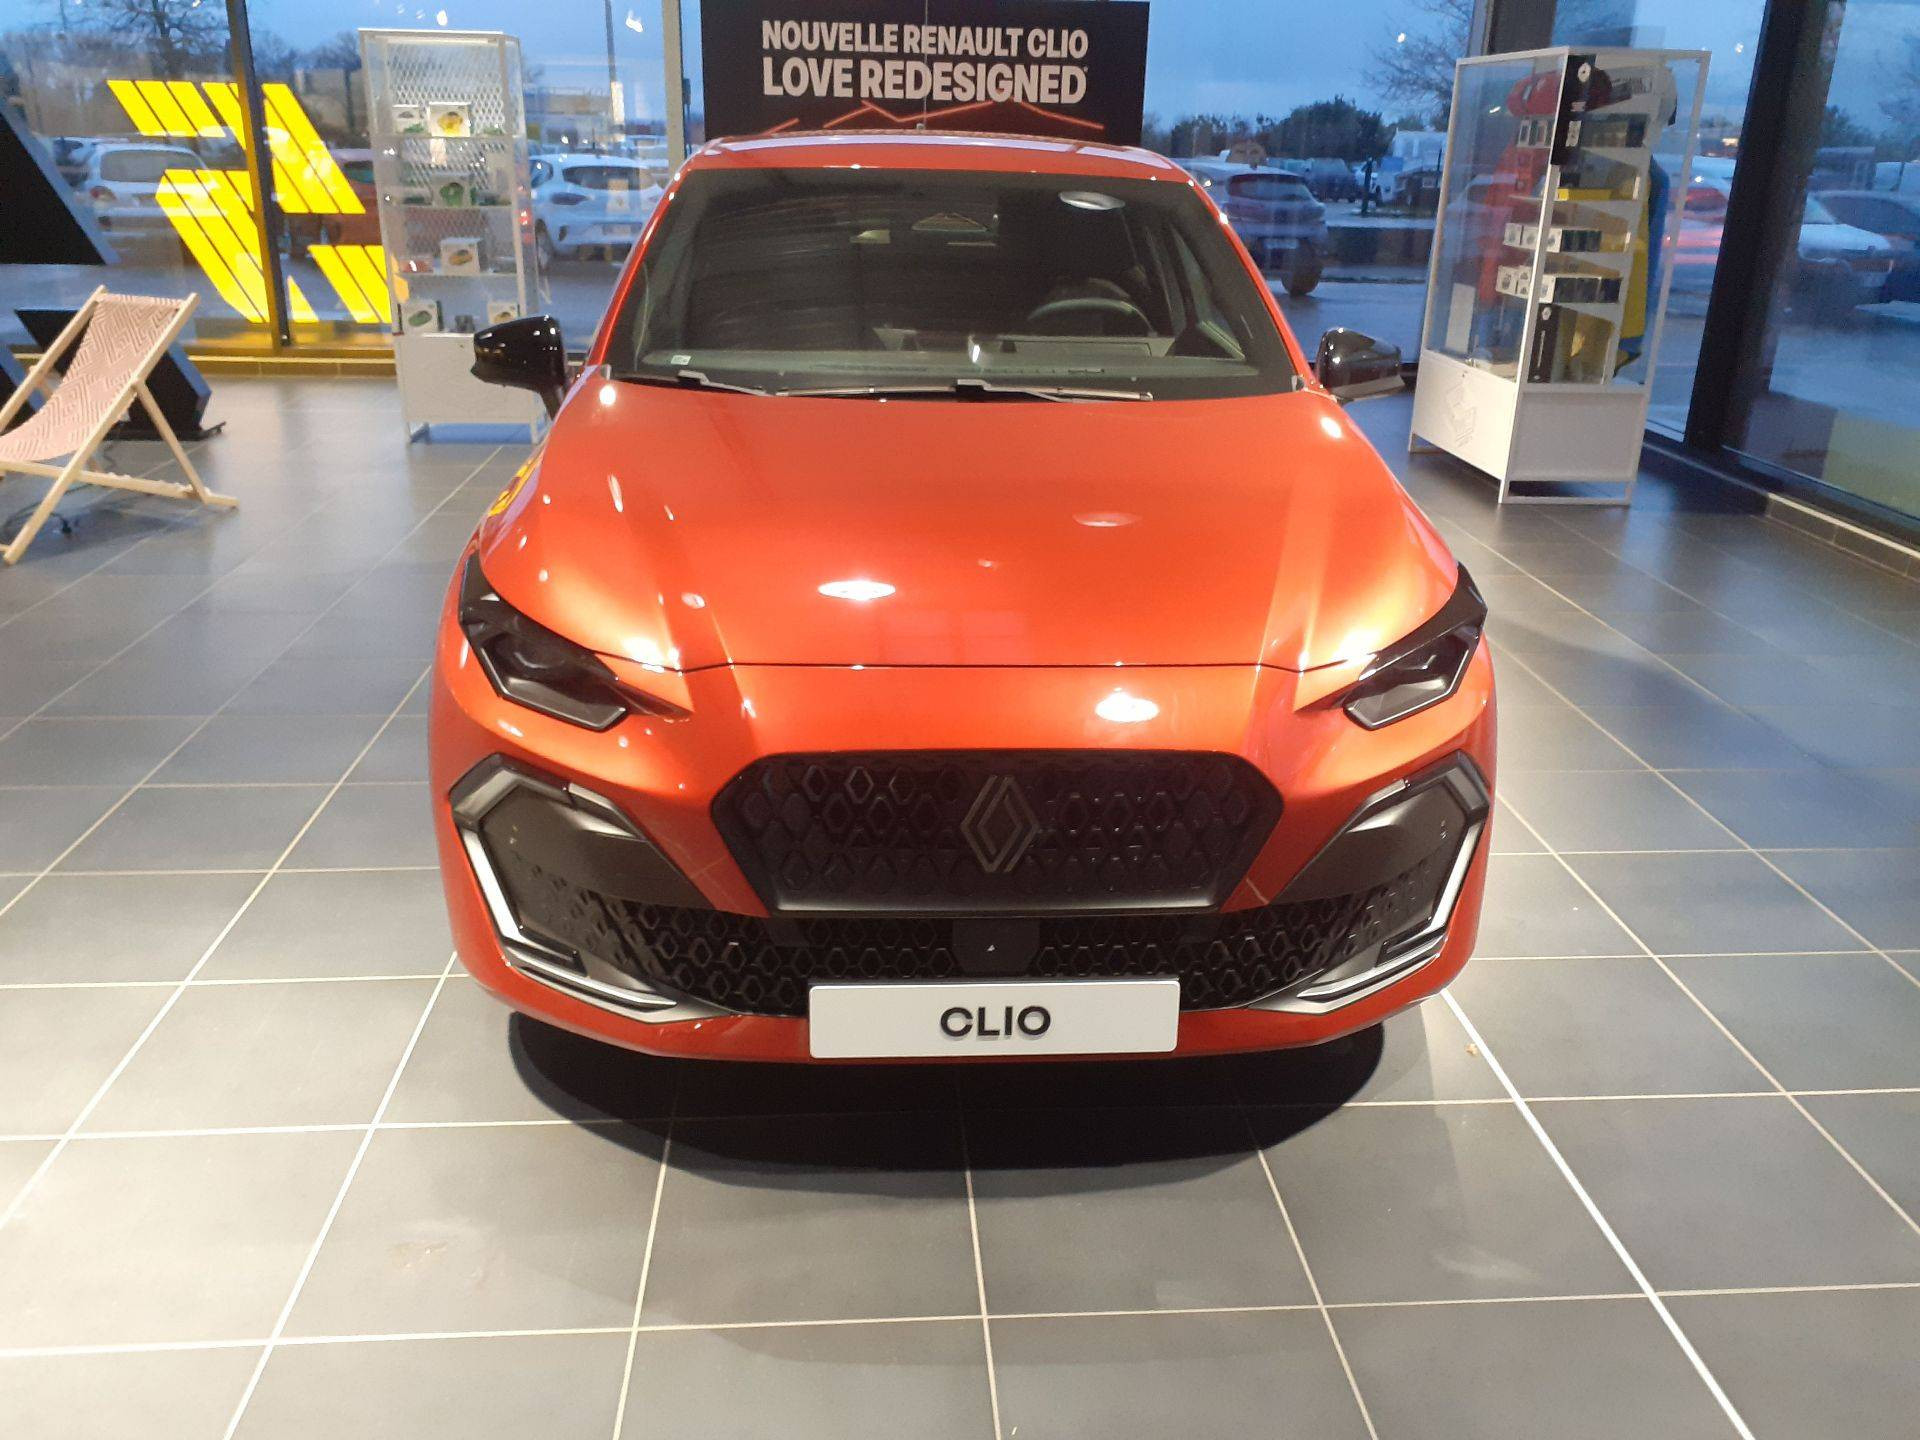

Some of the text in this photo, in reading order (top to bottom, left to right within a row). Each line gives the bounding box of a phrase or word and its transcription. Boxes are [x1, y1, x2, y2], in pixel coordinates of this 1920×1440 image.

[762, 20, 1088, 58] NOUVELLE RENAULT CLIO
[763, 57, 853, 97] LOVE
[940, 1006, 1051, 1037] CLIO
